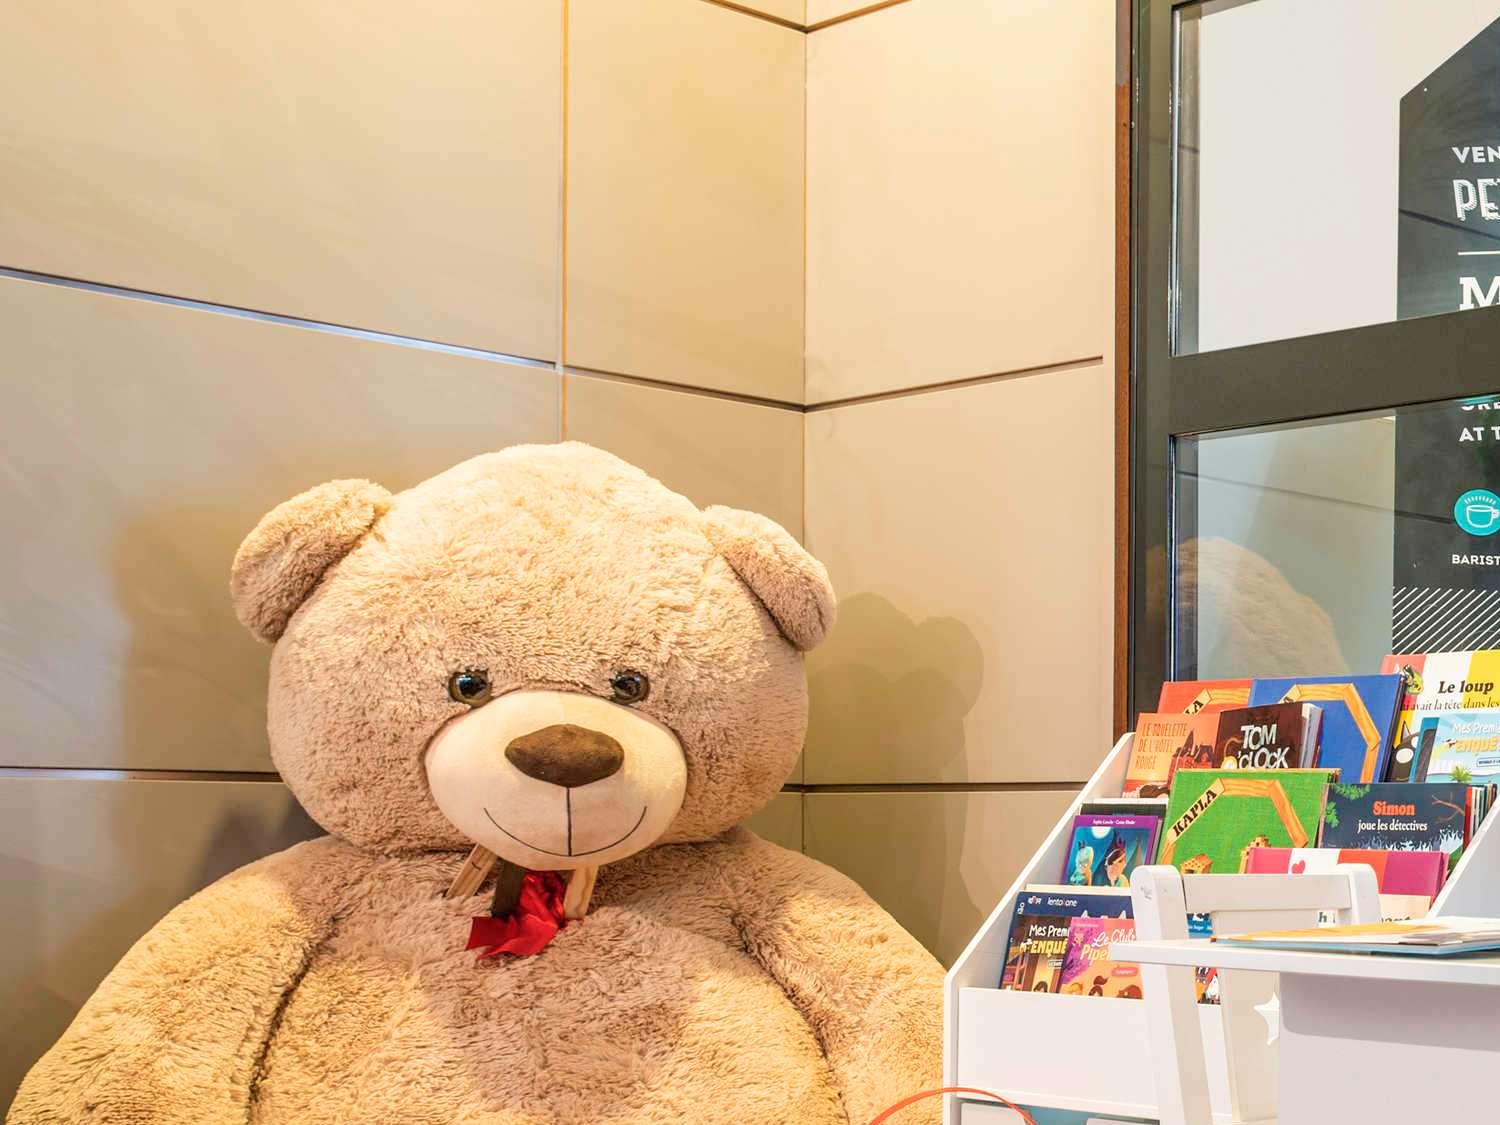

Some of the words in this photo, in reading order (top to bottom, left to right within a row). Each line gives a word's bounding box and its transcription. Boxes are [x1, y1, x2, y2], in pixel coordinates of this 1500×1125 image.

[1459, 426, 1485, 442] AT
[1438, 681, 1456, 694] Le
[1460, 680, 1494, 695] loup
[1241, 724, 1277, 749] TOM
[1173, 789, 1218, 836] KAPLA
[1373, 801, 1416, 816] Simon
[1357, 820, 1376, 833] joue
[1377, 819, 1388, 831] les
[1389, 819, 1428, 831] détectives
[1029, 925, 1047, 937] Mes
